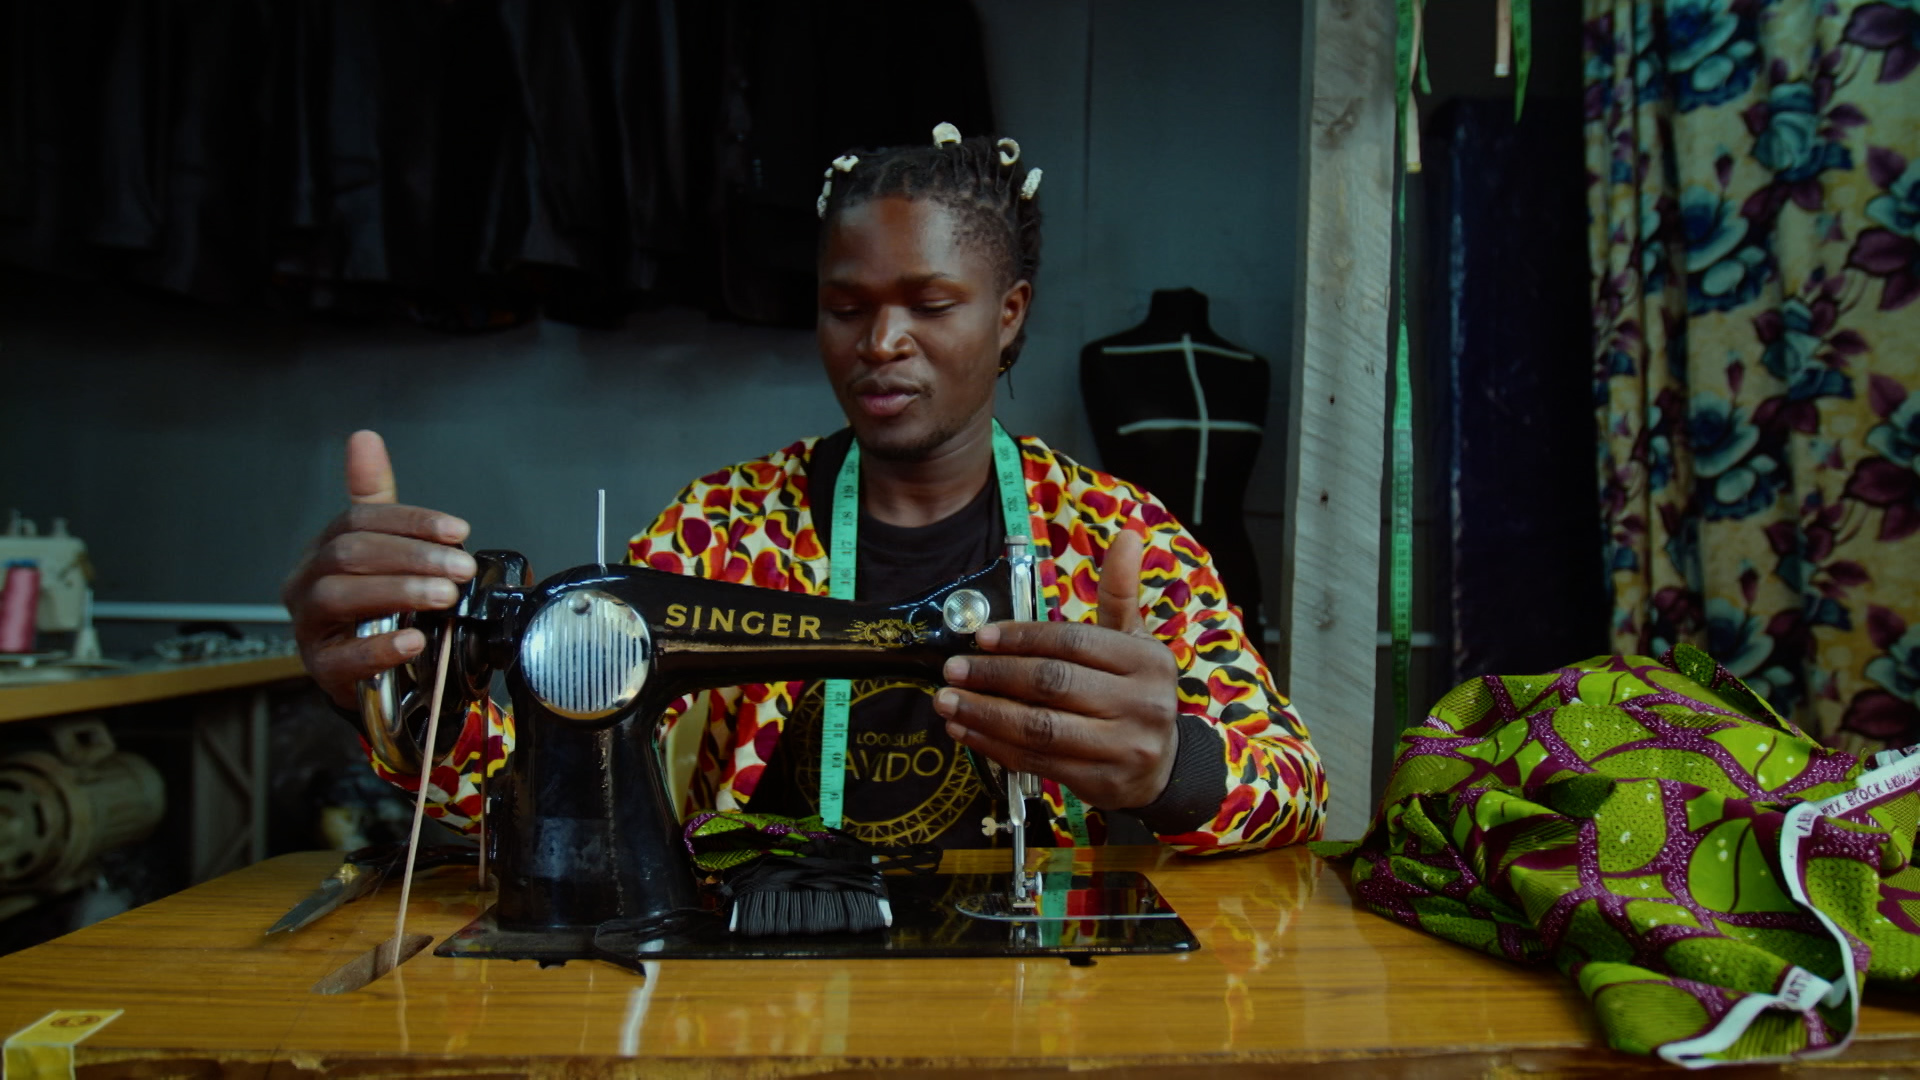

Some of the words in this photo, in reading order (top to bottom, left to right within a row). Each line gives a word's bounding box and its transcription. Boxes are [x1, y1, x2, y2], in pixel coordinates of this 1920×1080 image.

[844, 485, 854, 498] 19
[842, 511, 853, 526] 18
[841, 540, 852, 555] 17
[665, 603, 821, 640] SINGER
[835, 691, 846, 706] 12
[832, 752, 842, 768] 10
